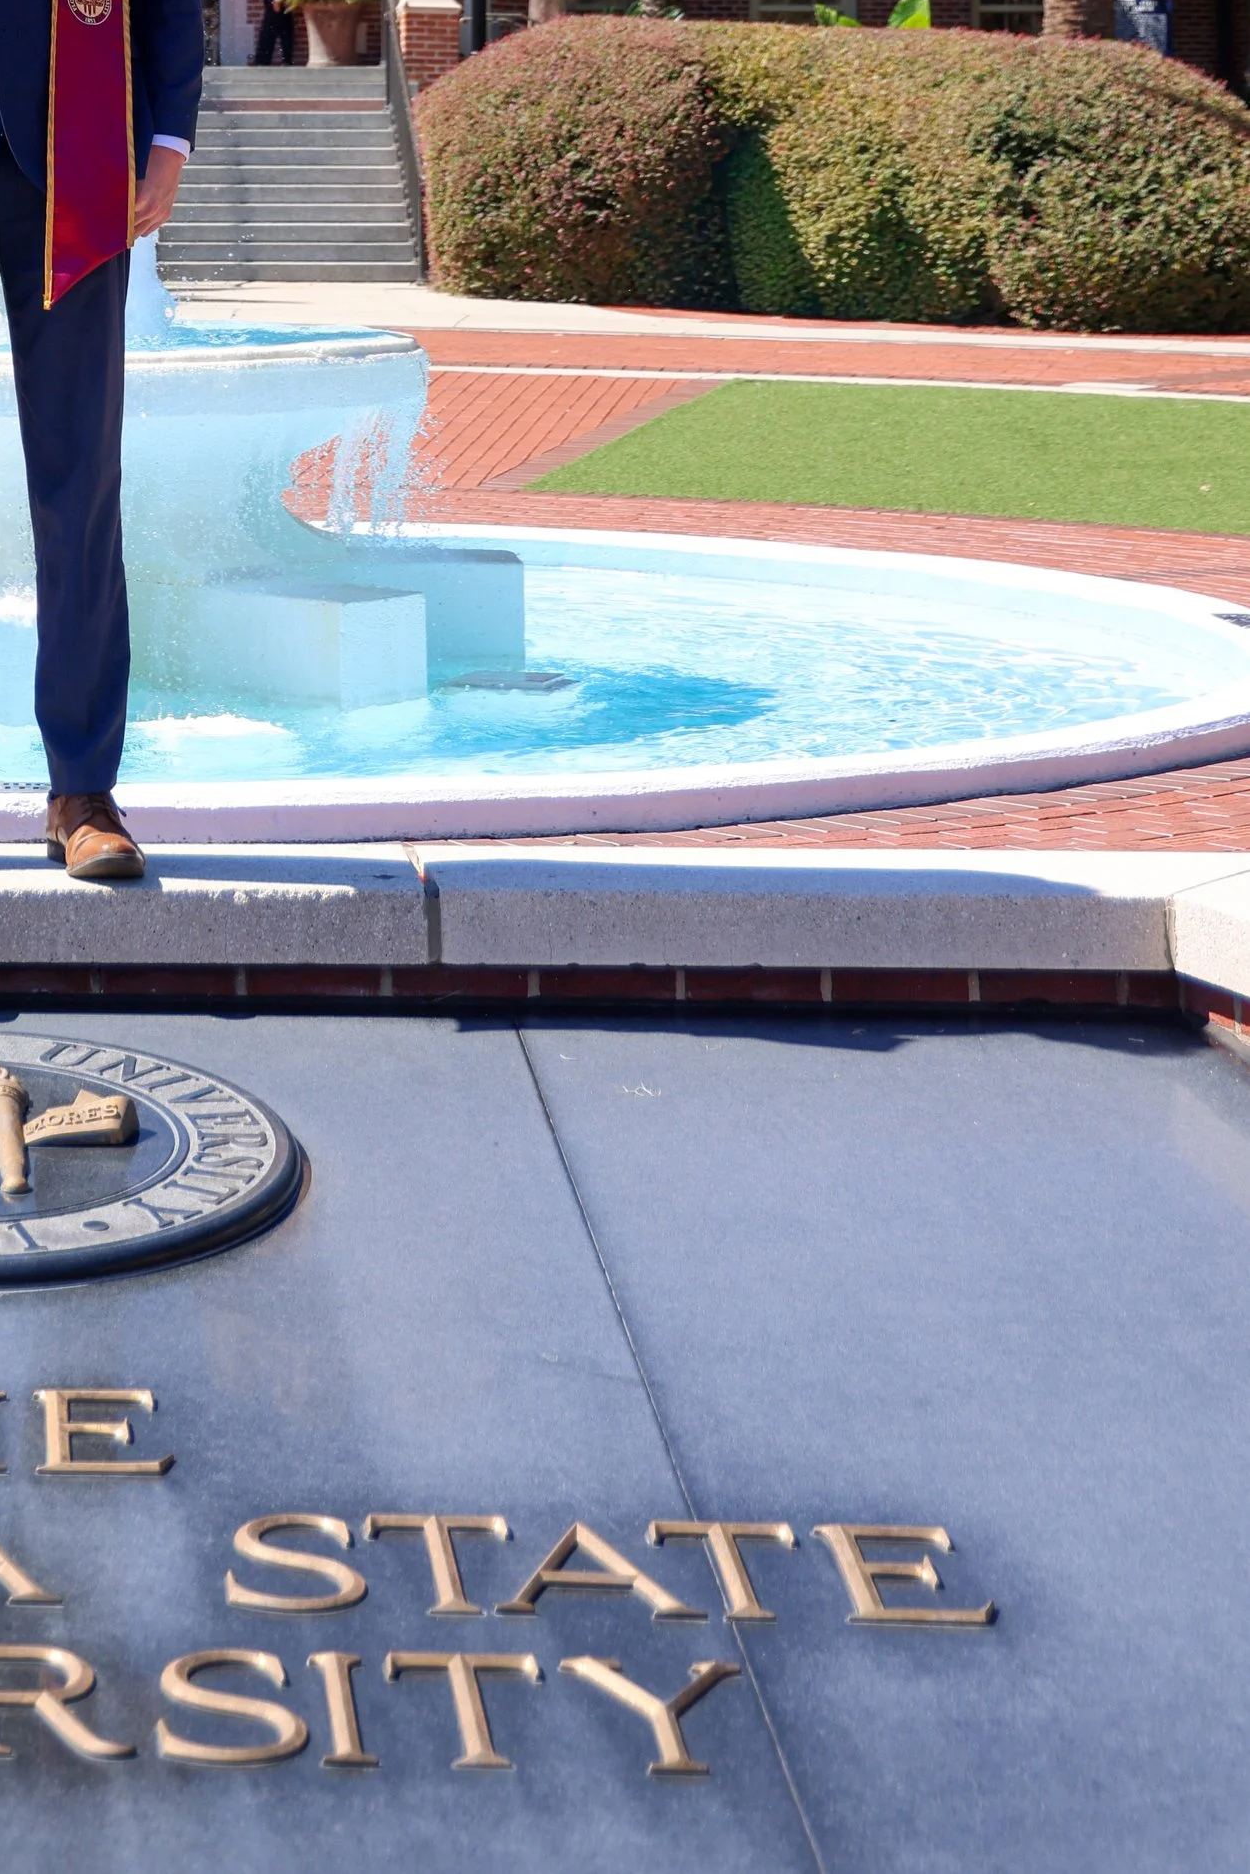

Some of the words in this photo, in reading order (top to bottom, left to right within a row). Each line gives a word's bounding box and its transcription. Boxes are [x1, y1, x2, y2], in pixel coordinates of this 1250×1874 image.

[25, 1104, 122, 1135] MORES
[39, 1041, 268, 1228] UNIVERSITY
[224, 1511, 996, 1626] STATE
